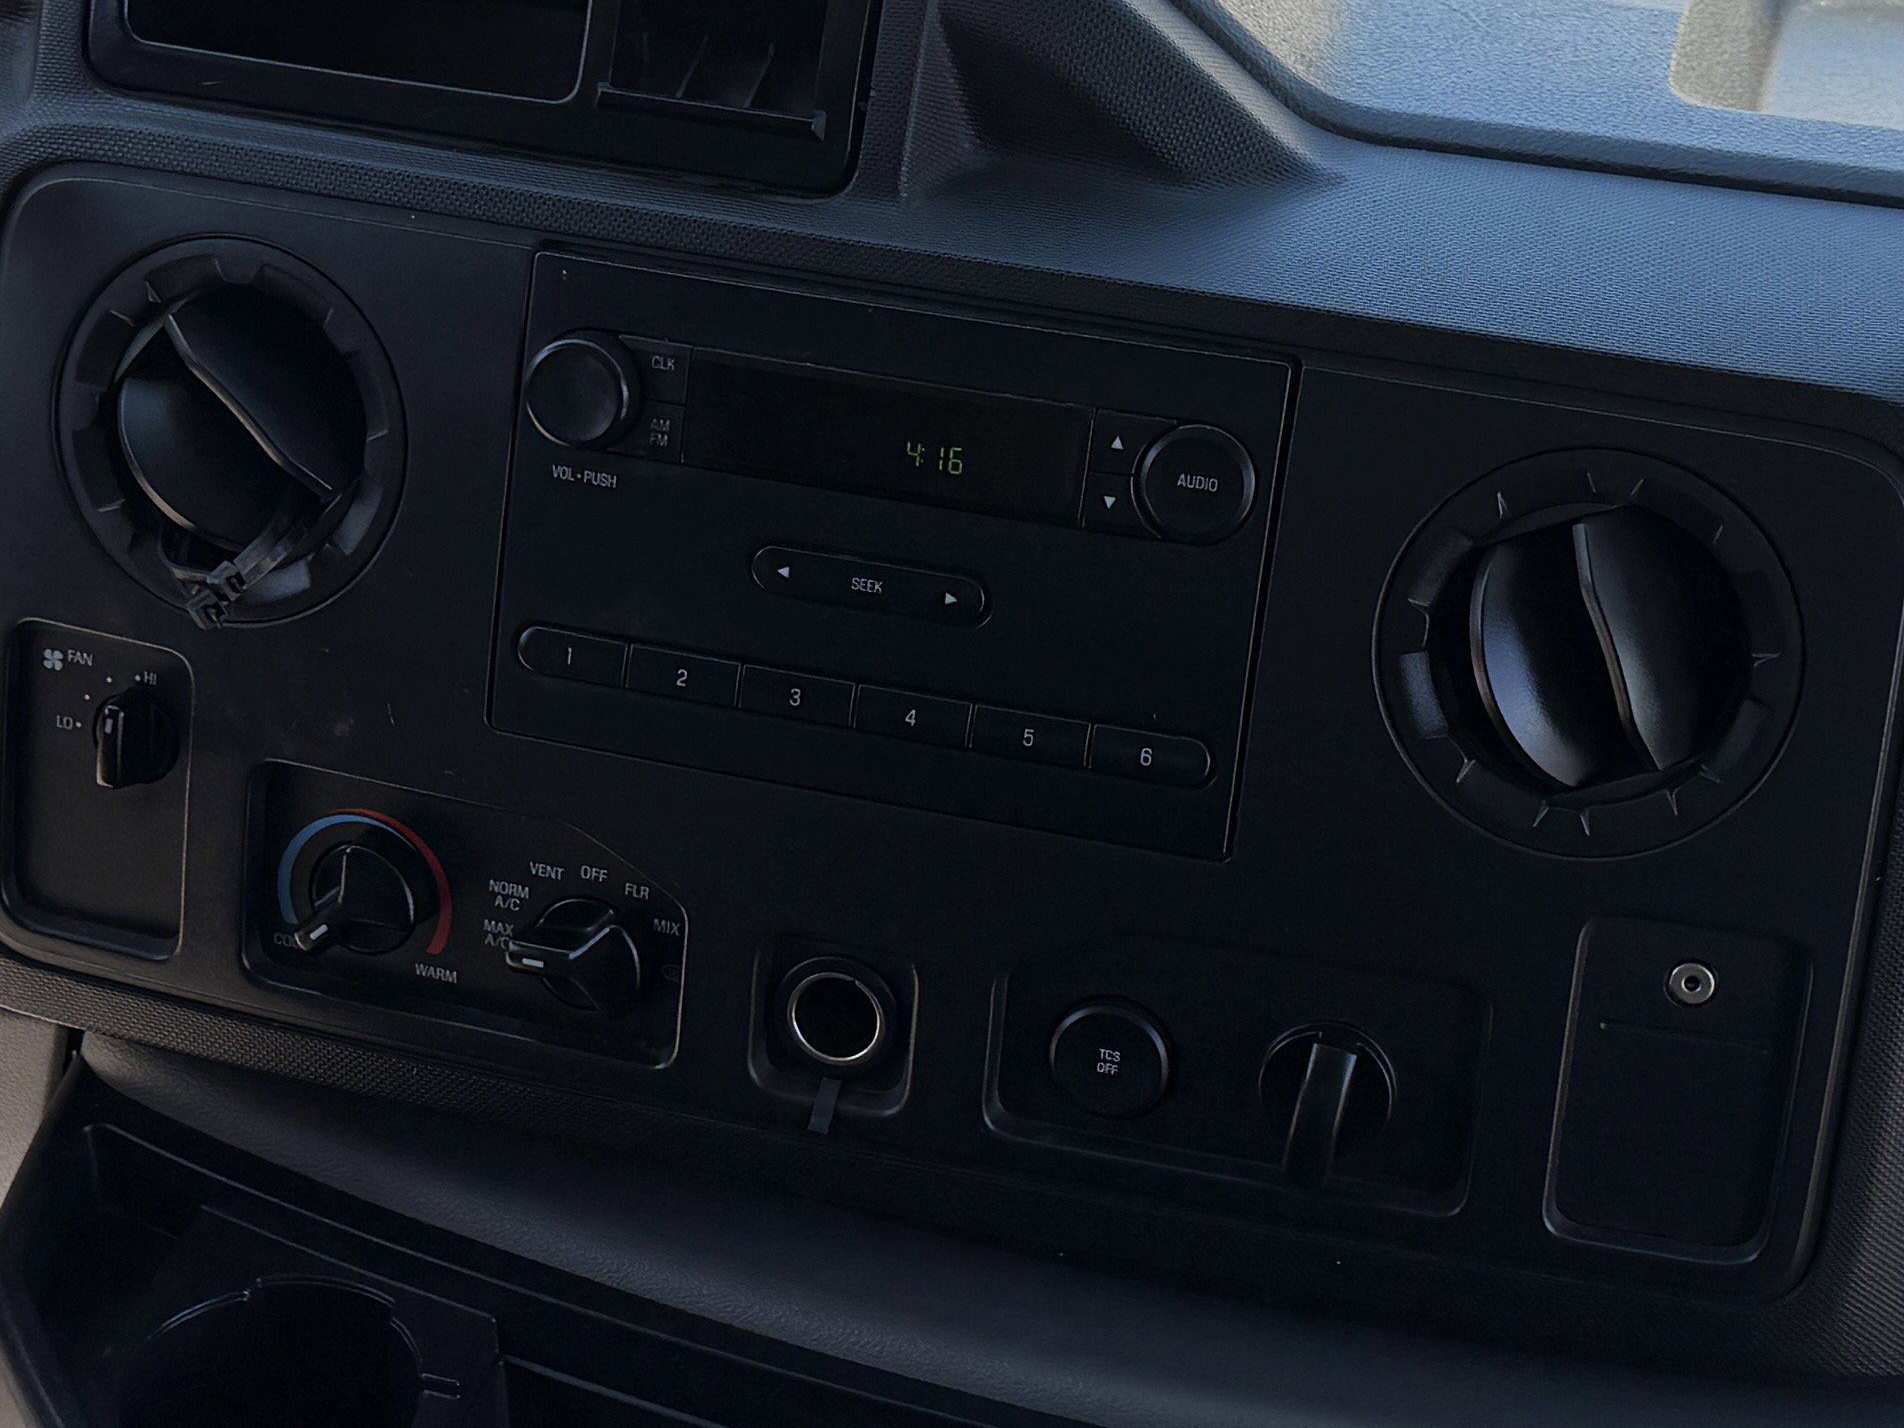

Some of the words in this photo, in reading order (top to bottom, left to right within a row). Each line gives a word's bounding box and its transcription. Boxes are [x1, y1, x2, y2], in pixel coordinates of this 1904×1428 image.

[651, 355, 676, 372] CLK
[650, 418, 672, 433] AM
[649, 432, 670, 448] FM
[906, 441, 964, 476] 4:16
[1176, 473, 1220, 494] AUDIO
[850, 576, 884, 595] SEEK
[67, 649, 94, 667] FAN
[565, 646, 573, 665] 1
[143, 670, 158, 685] HI
[676, 670, 688, 688] 2
[789, 688, 802, 707] 3
[56, 715, 74, 730] LO
[904, 708, 917, 727] 4
[1022, 729, 1035, 748] 5
[1140, 748, 1153, 767] 6
[530, 862, 565, 881] VENT
[581, 865, 609, 883] OFF
[489, 879, 530, 900] NORM
[625, 883, 651, 901] FLR
[495, 894, 521, 912] A/C
[483, 919, 514, 937] MAX
[654, 917, 682, 936] MIX
[415, 962, 459, 984] WARM
[1098, 1048, 1122, 1063] TCS
[1096, 1062, 1120, 1077] OFF
